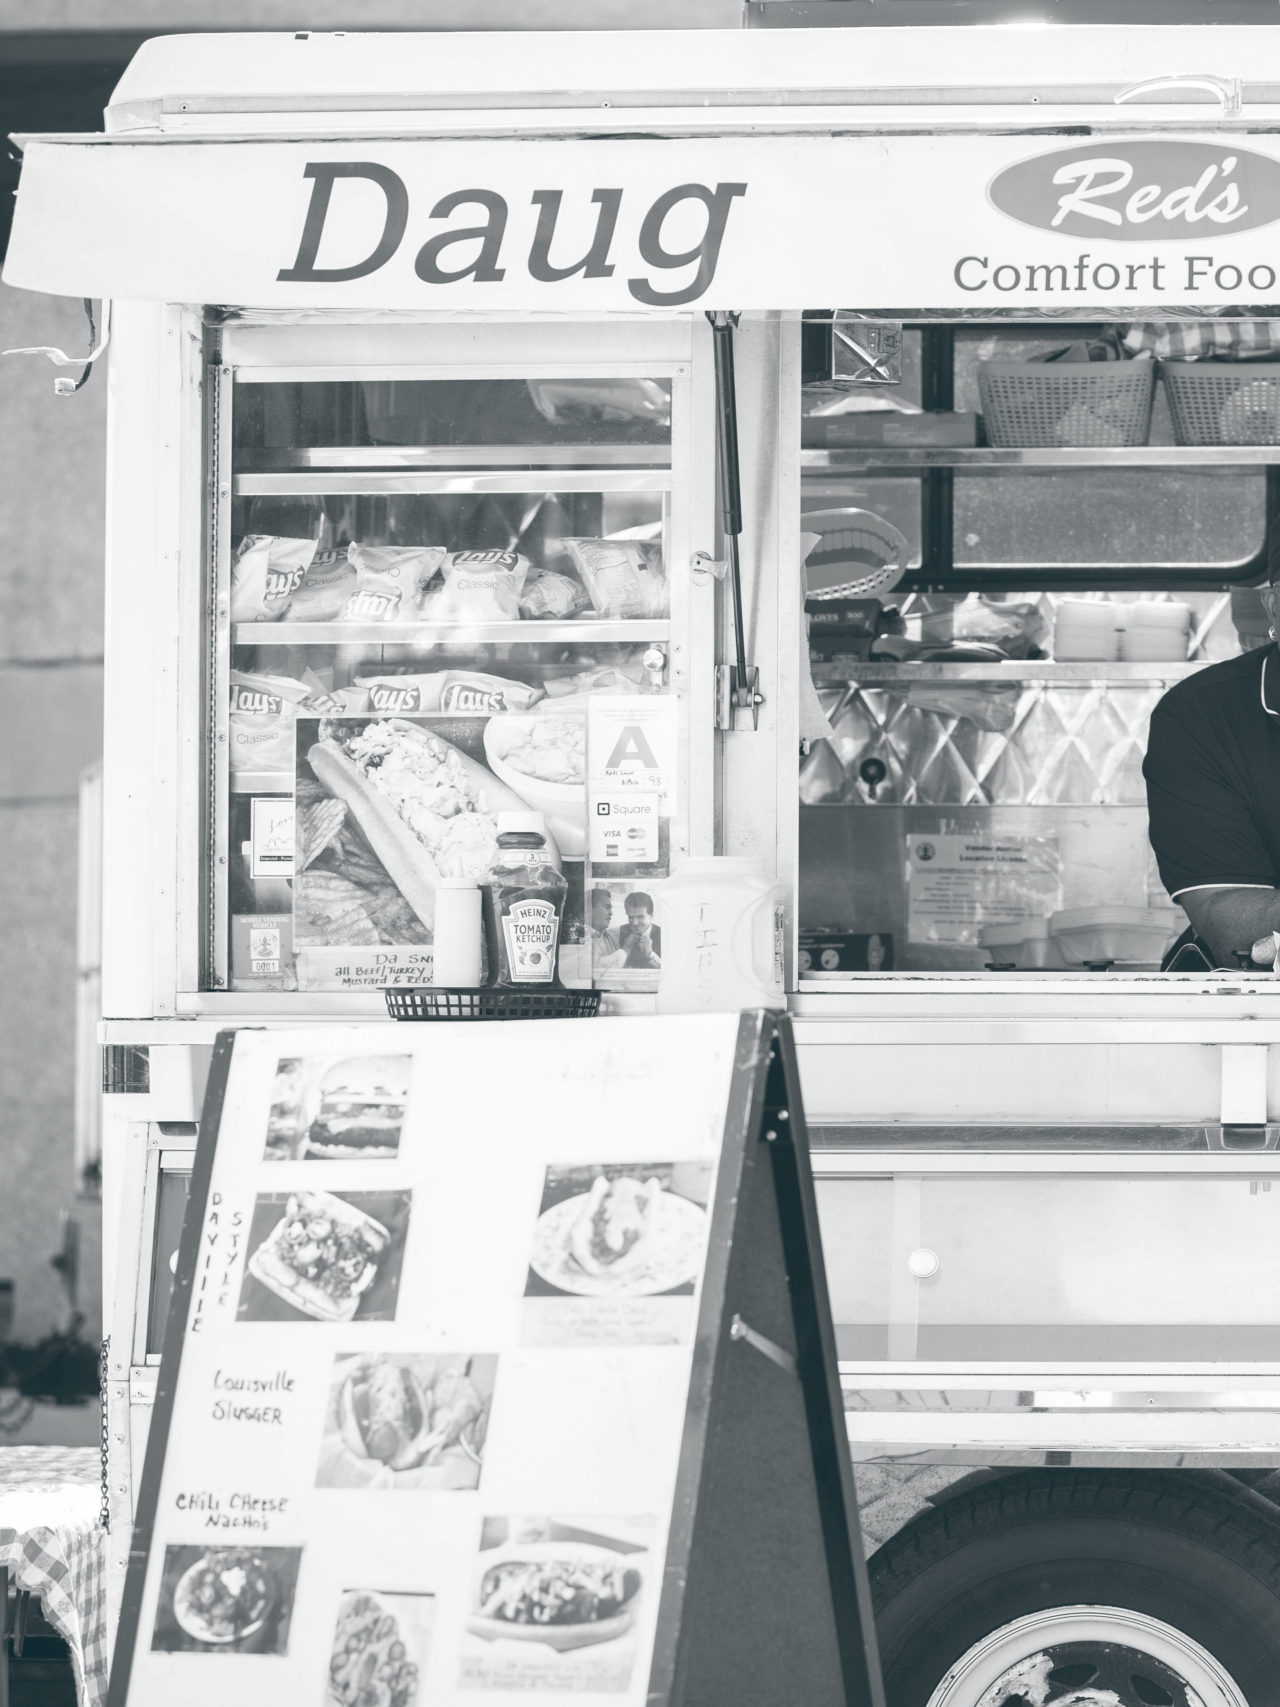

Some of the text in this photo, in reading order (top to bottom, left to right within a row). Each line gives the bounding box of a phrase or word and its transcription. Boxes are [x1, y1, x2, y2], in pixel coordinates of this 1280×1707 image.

[1050, 156, 1249, 227] Red's
[275, 160, 748, 307] Daug
[953, 254, 1165, 293] Comfort
[605, 726, 660, 768] A
[613, 804, 652, 815] Square
[603, 830, 622, 838] VISA
[520, 908, 547, 919] HEINZ
[514, 925, 552, 935] TOMATO
[516, 934, 551, 944] KETCHUP
[408, 953, 434, 964] SN
